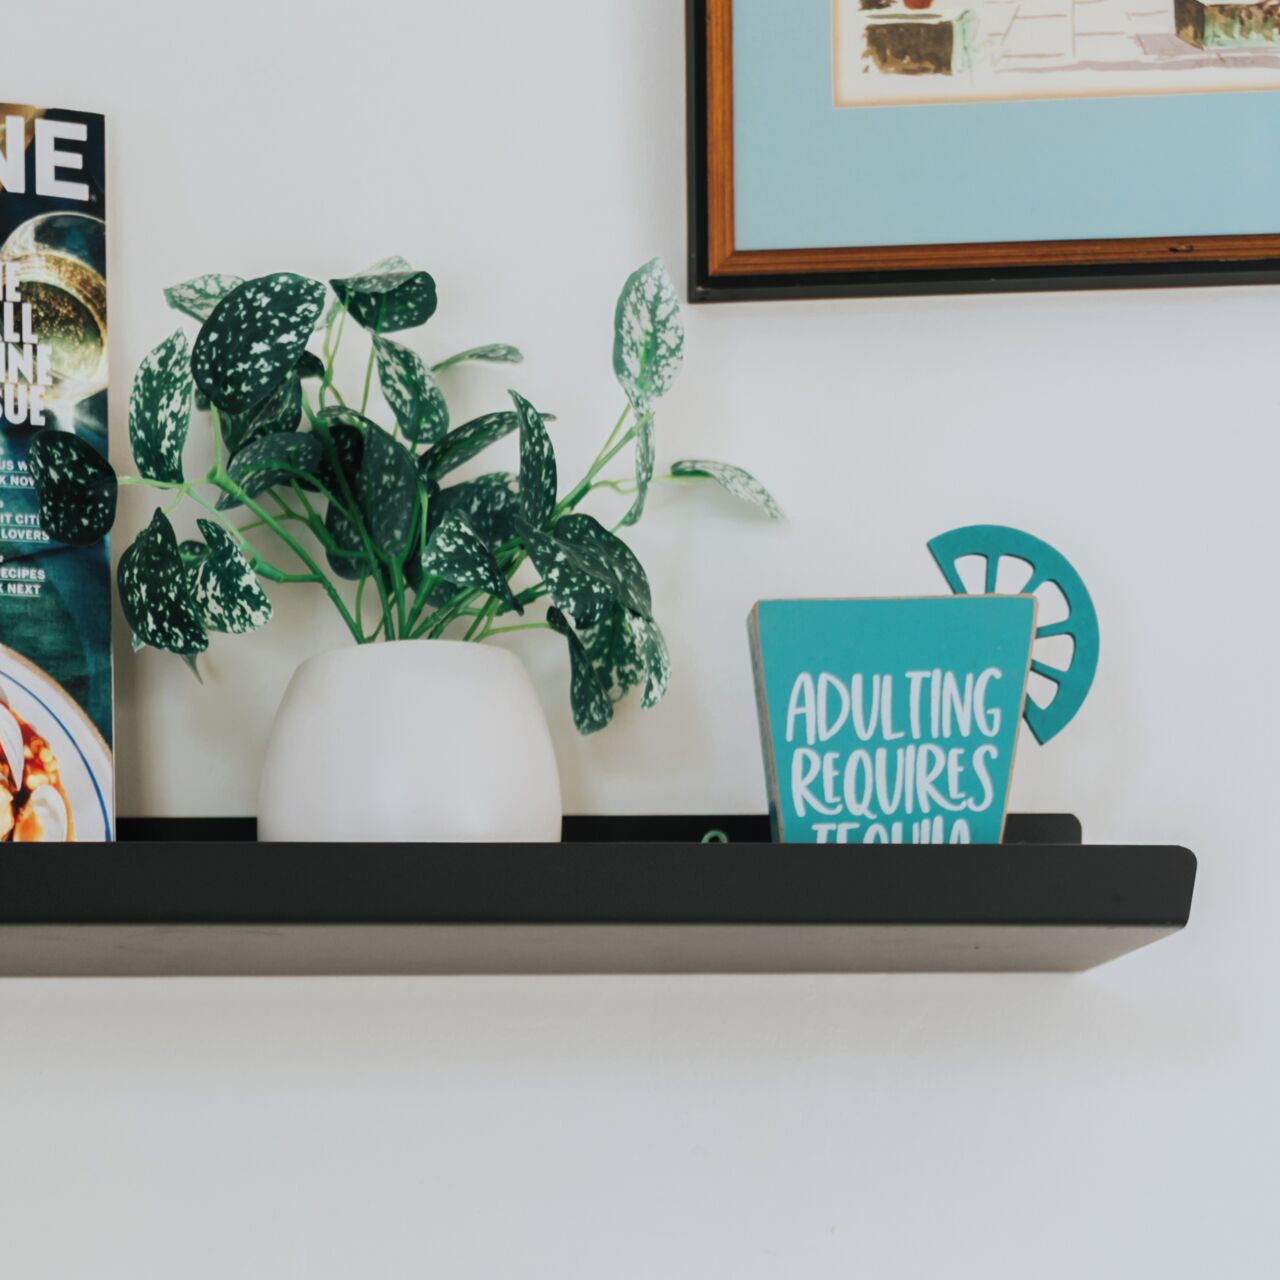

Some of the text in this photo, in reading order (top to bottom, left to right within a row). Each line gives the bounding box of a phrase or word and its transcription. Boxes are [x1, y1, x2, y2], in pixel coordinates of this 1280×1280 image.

[1, 528, 50, 541] LOVERS
[7, 583, 41, 595] NEXT
[786, 667, 1003, 745] ADULTING
[790, 743, 1000, 819] REQUIRES
